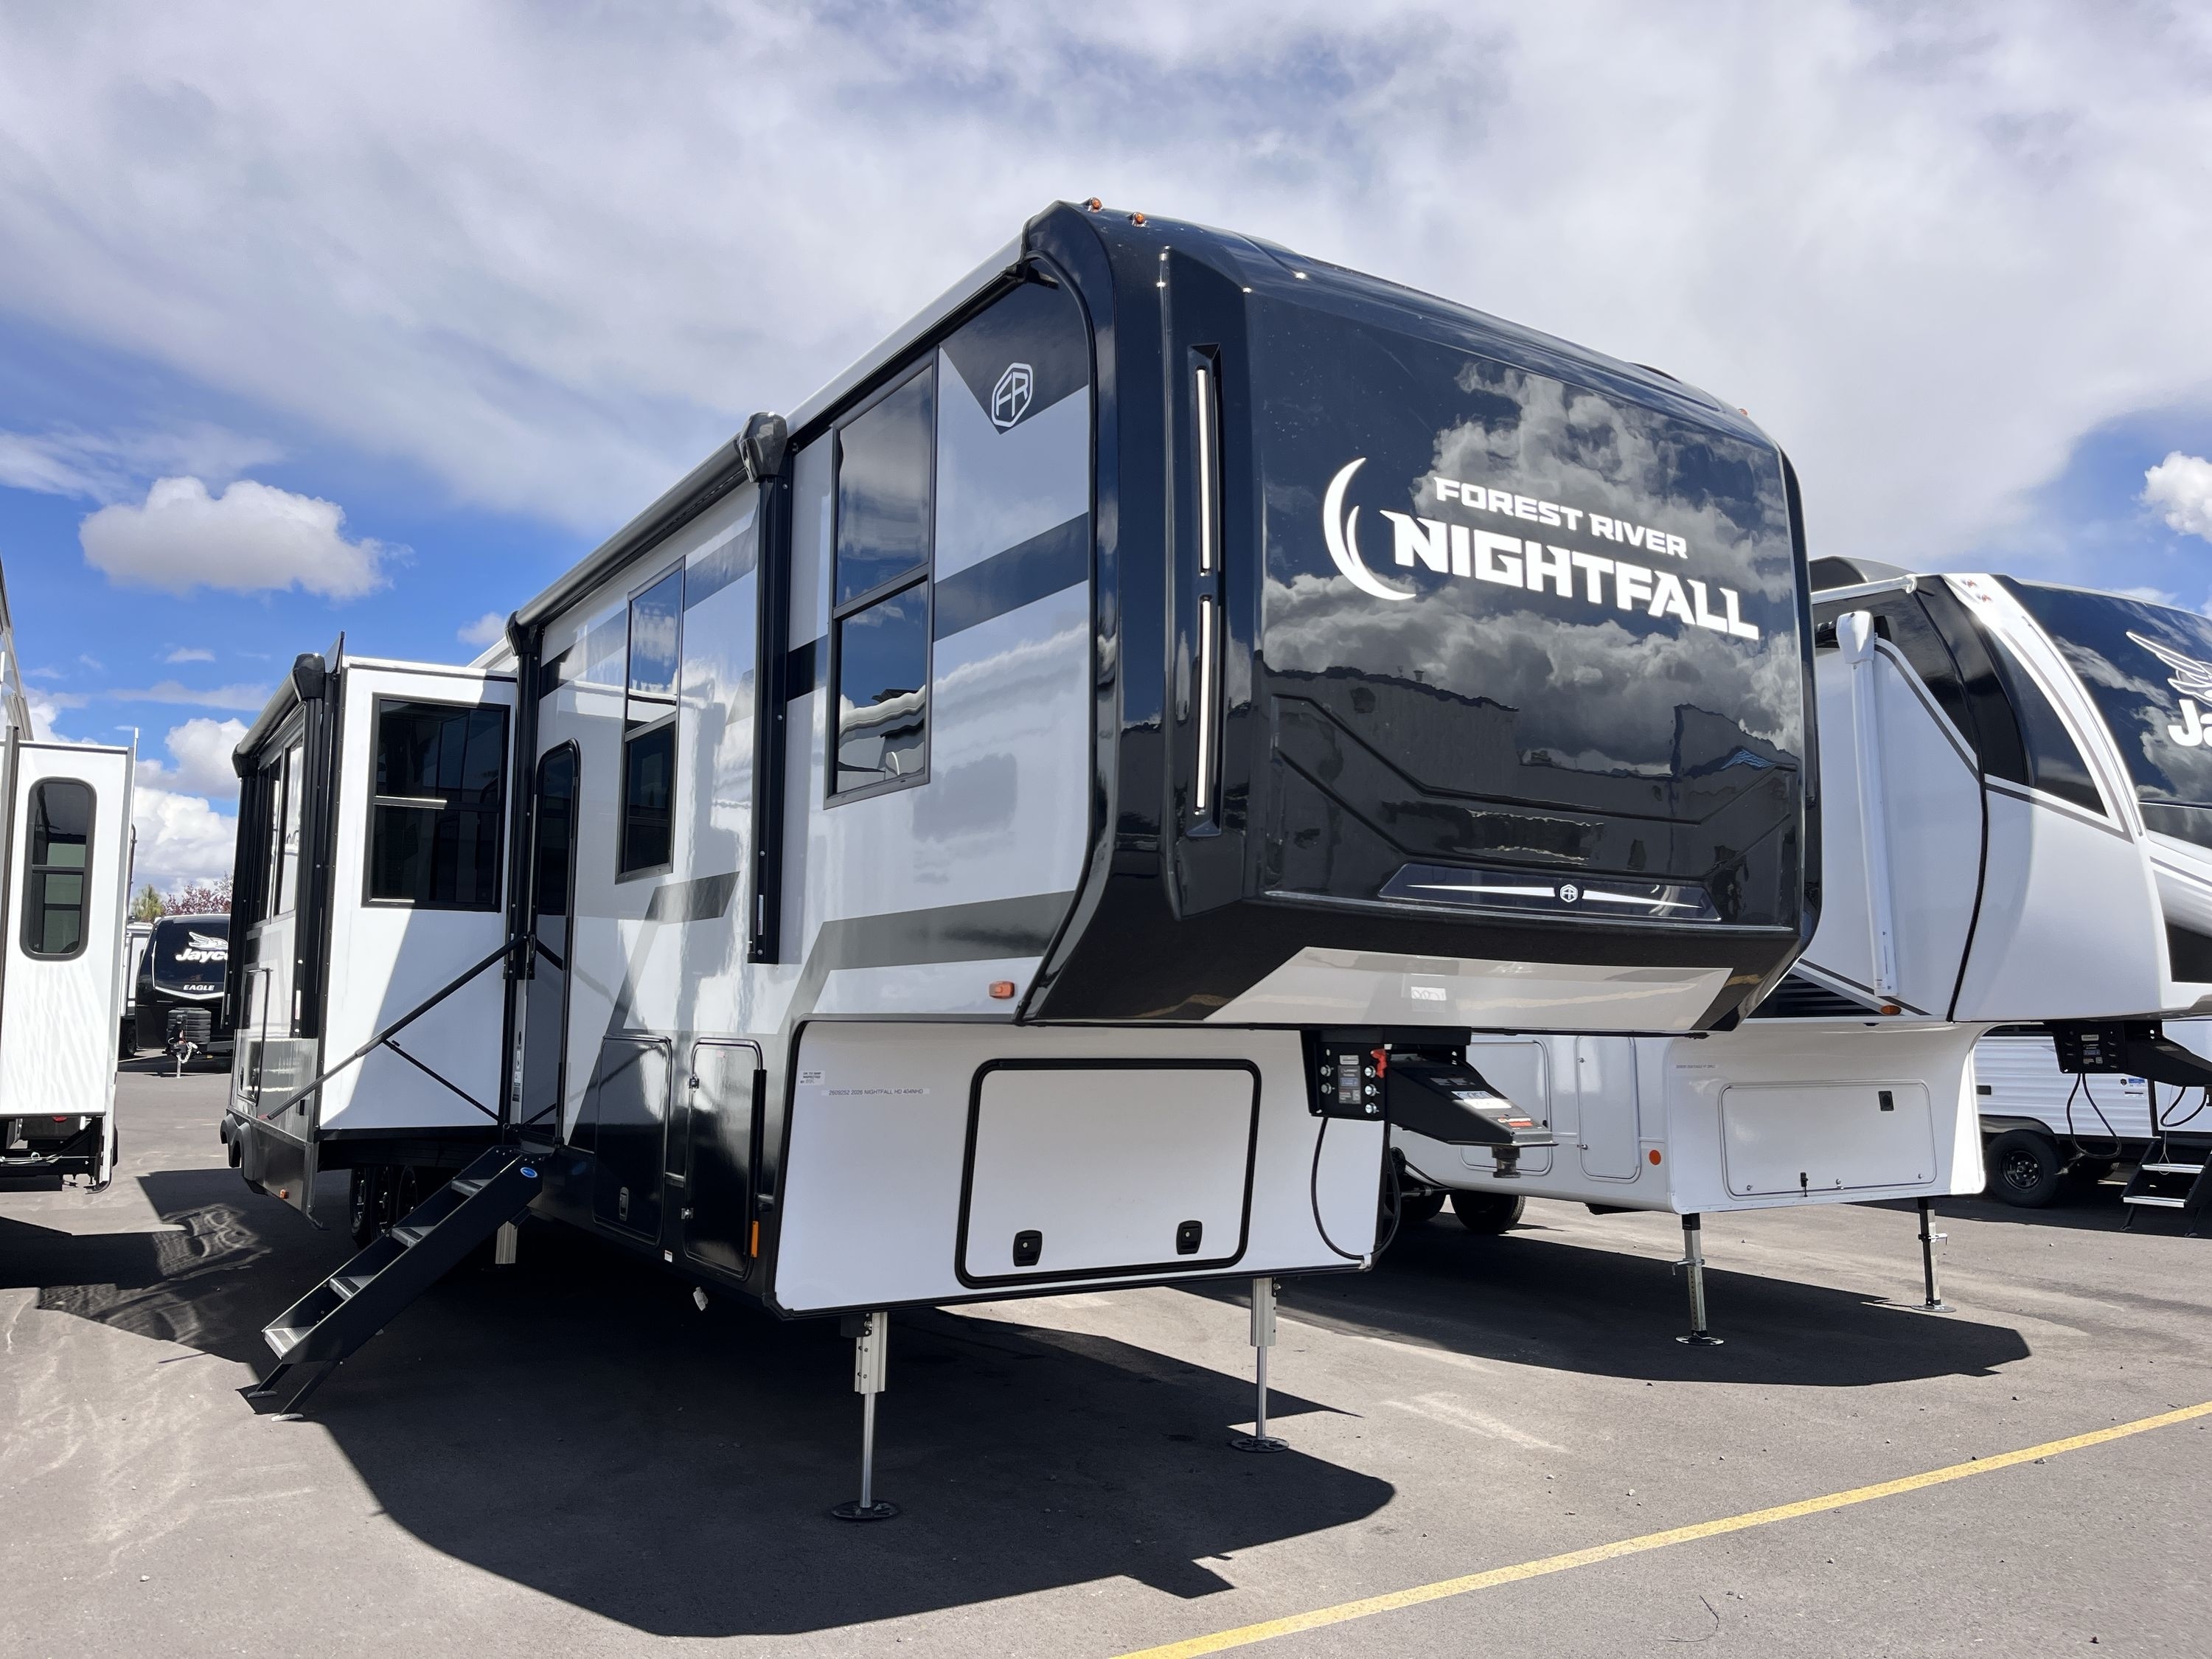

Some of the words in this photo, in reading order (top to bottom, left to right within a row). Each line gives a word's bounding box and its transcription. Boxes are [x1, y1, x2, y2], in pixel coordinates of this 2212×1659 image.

[1433, 476, 1582, 531] FOREST
[1588, 512, 1688, 560] RIVER
[1379, 509, 1760, 641] NIGHTFALL
